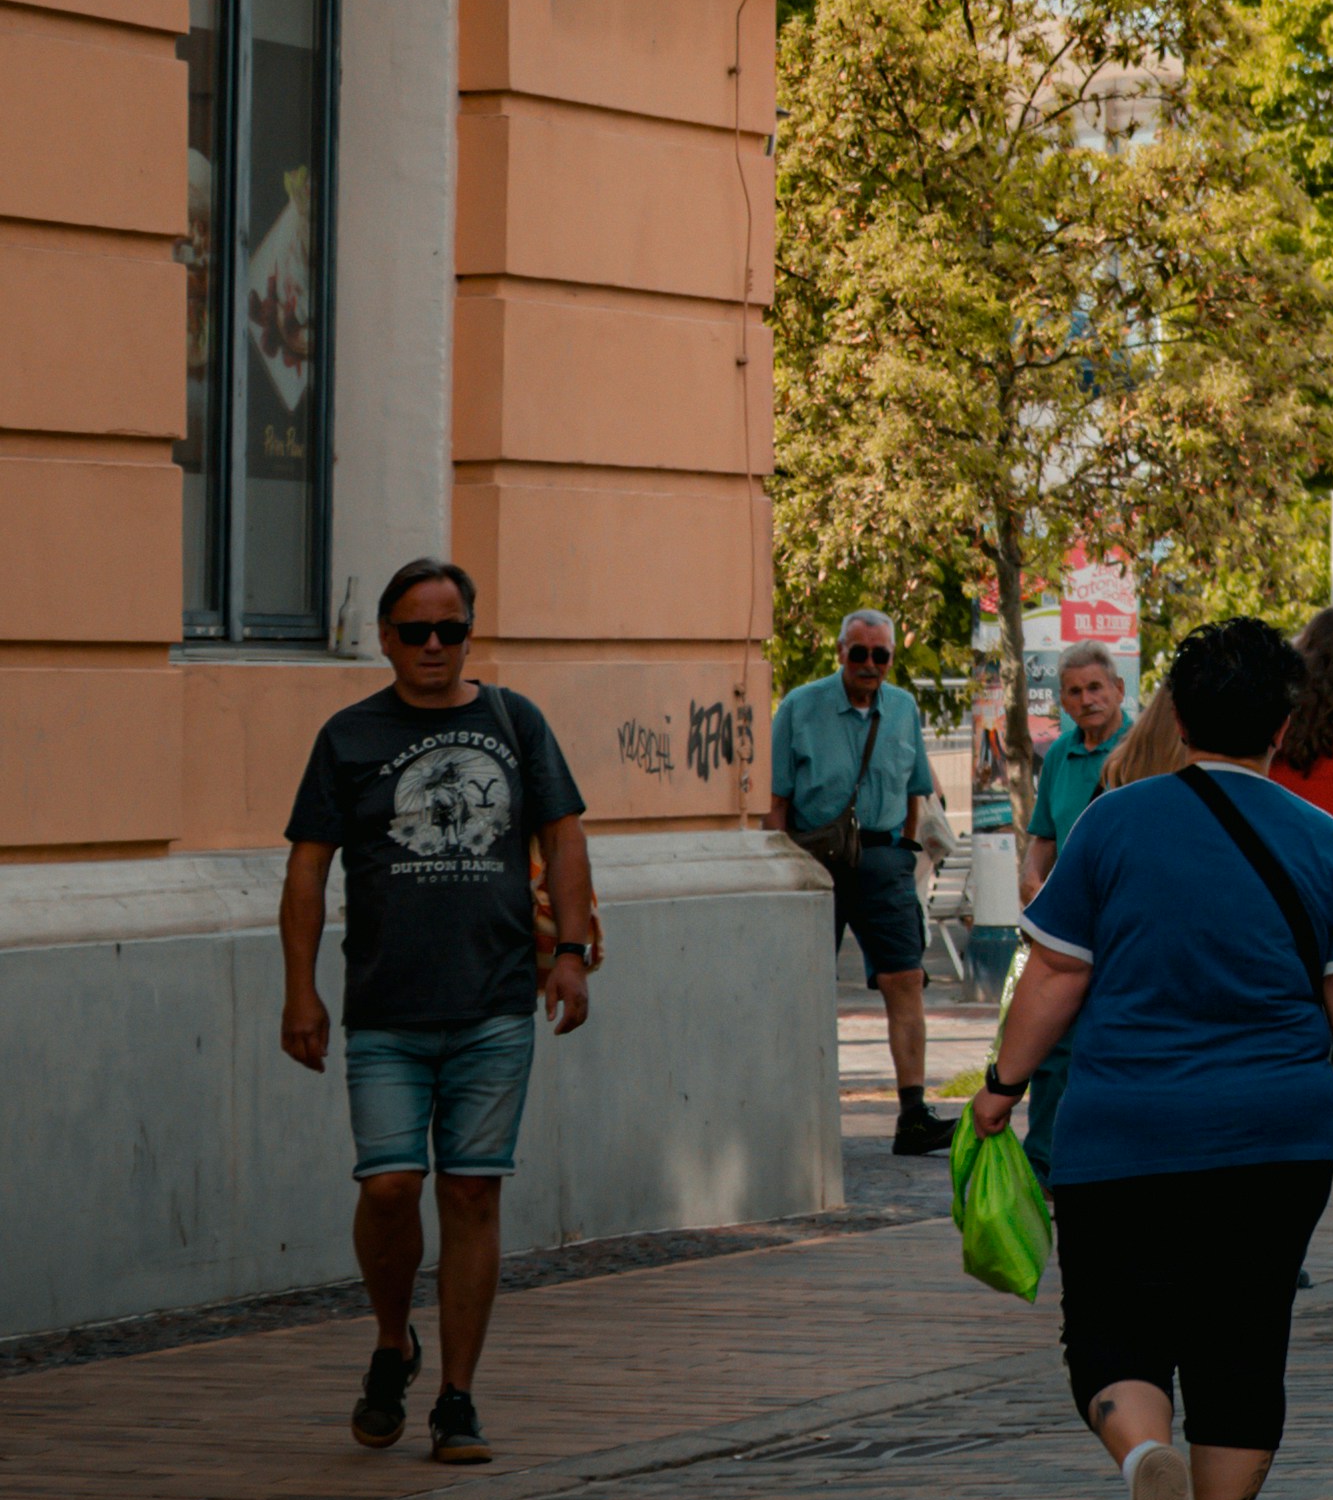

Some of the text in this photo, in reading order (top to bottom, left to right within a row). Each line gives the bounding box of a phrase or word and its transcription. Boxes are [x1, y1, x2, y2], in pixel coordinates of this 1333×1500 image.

[390, 859, 504, 875] DUTTON RANCH
[416, 873, 489, 885] MONTANA
